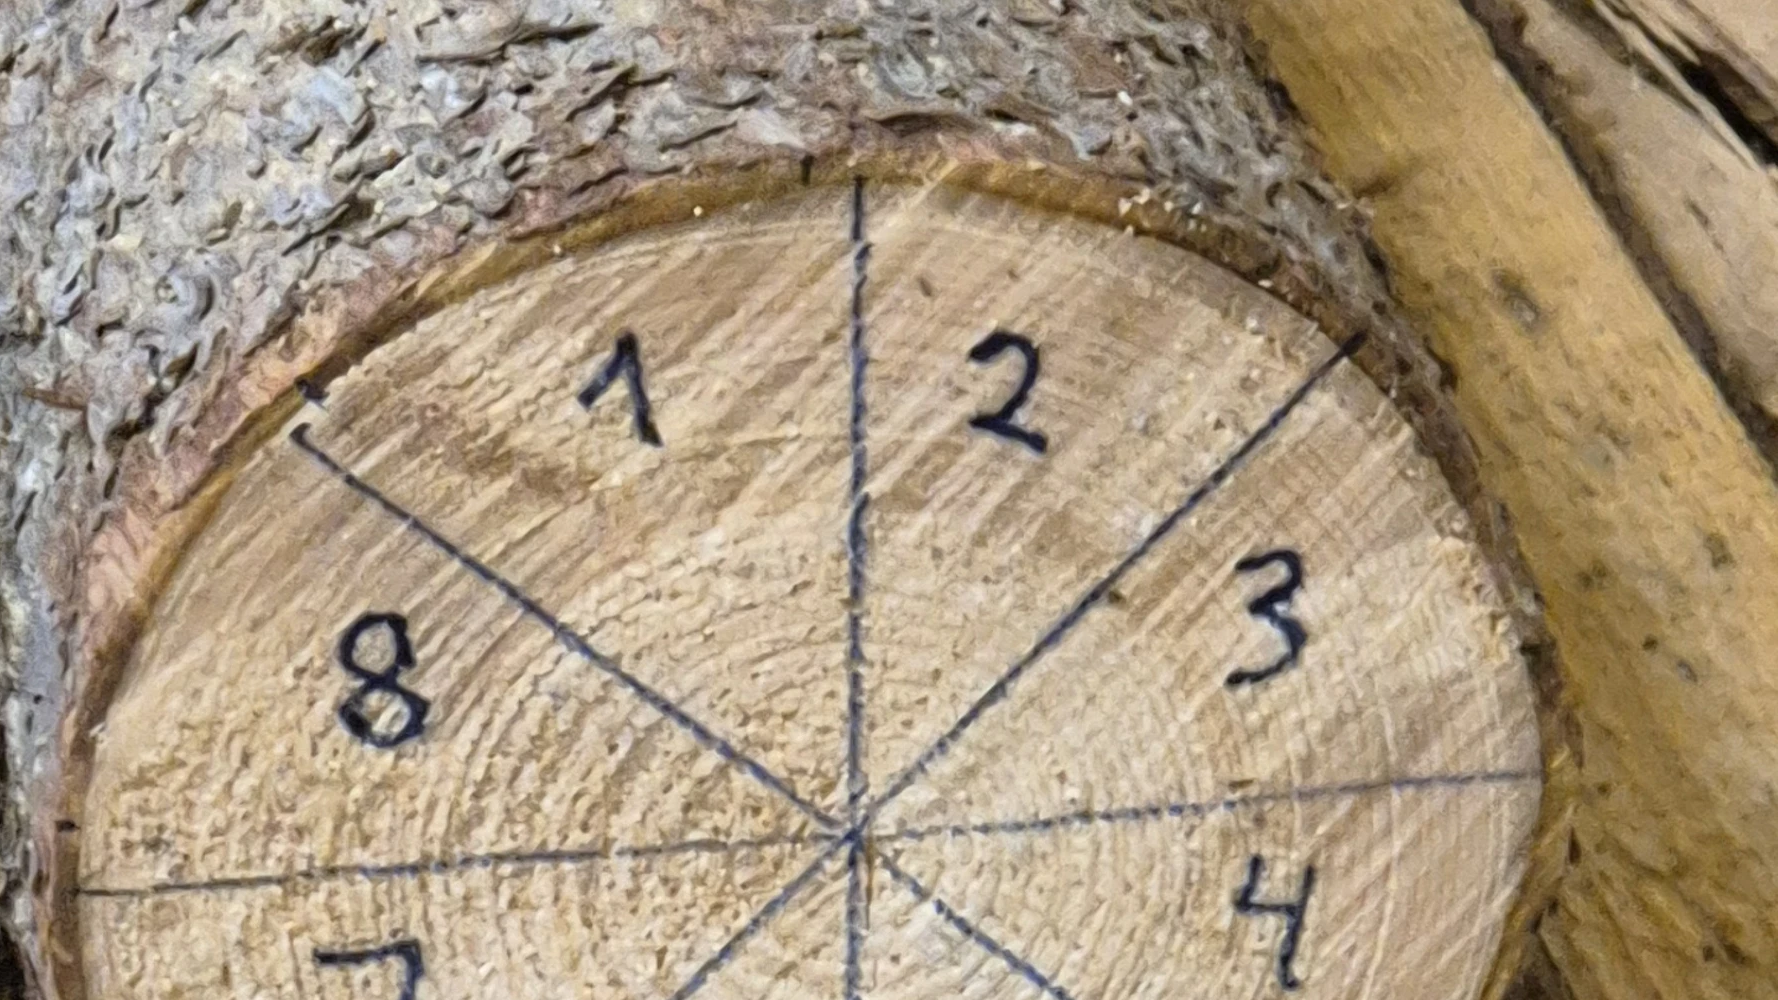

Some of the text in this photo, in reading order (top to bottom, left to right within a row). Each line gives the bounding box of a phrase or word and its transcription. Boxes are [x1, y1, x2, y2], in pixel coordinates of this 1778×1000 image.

[578, 331, 661, 446] 1
[967, 330, 1048, 454] 2
[337, 612, 431, 749] 8
[1226, 549, 1308, 688] 3
[1232, 854, 1316, 991] 4
